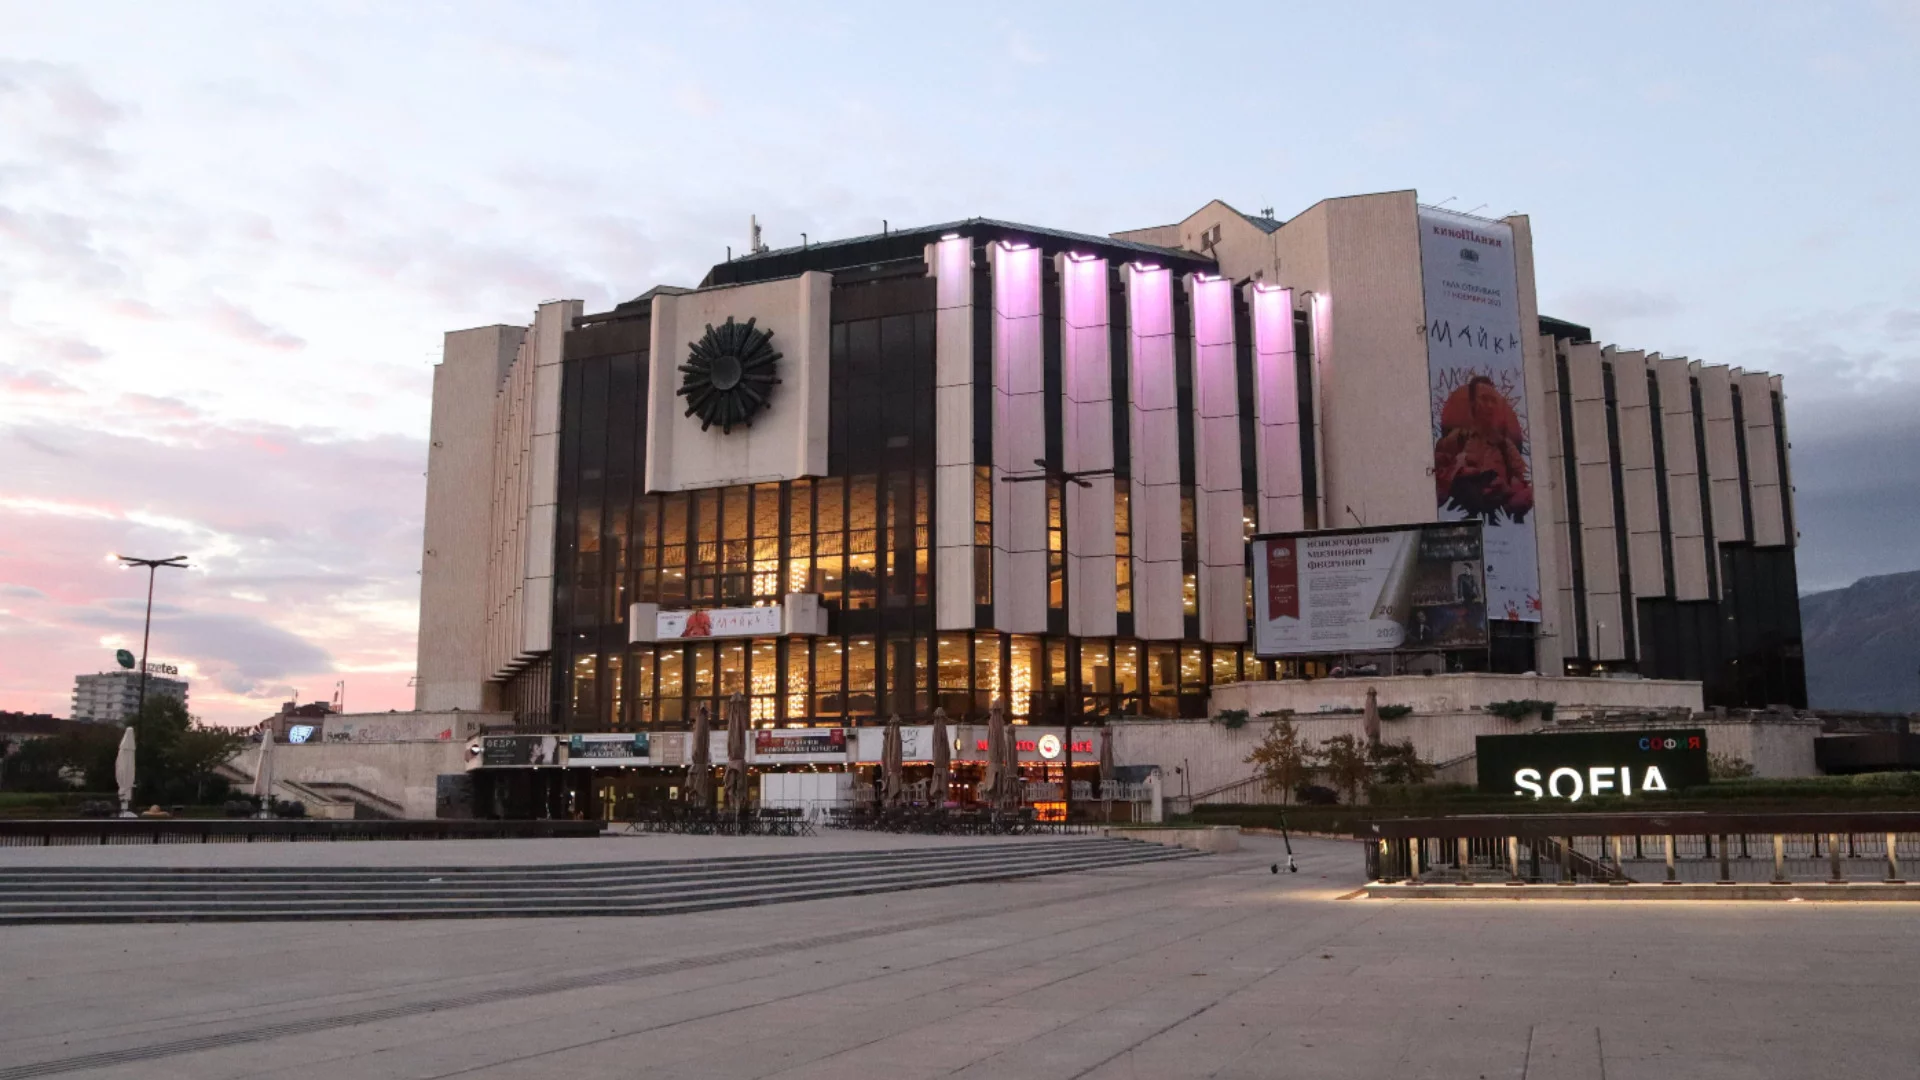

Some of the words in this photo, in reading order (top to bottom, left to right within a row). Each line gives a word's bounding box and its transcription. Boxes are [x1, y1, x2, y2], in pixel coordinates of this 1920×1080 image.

[1431, 319, 1519, 354] МАЙКА
[1639, 736, 1700, 751] СОФИЯ
[1514, 765, 1667, 803] SOFIA
